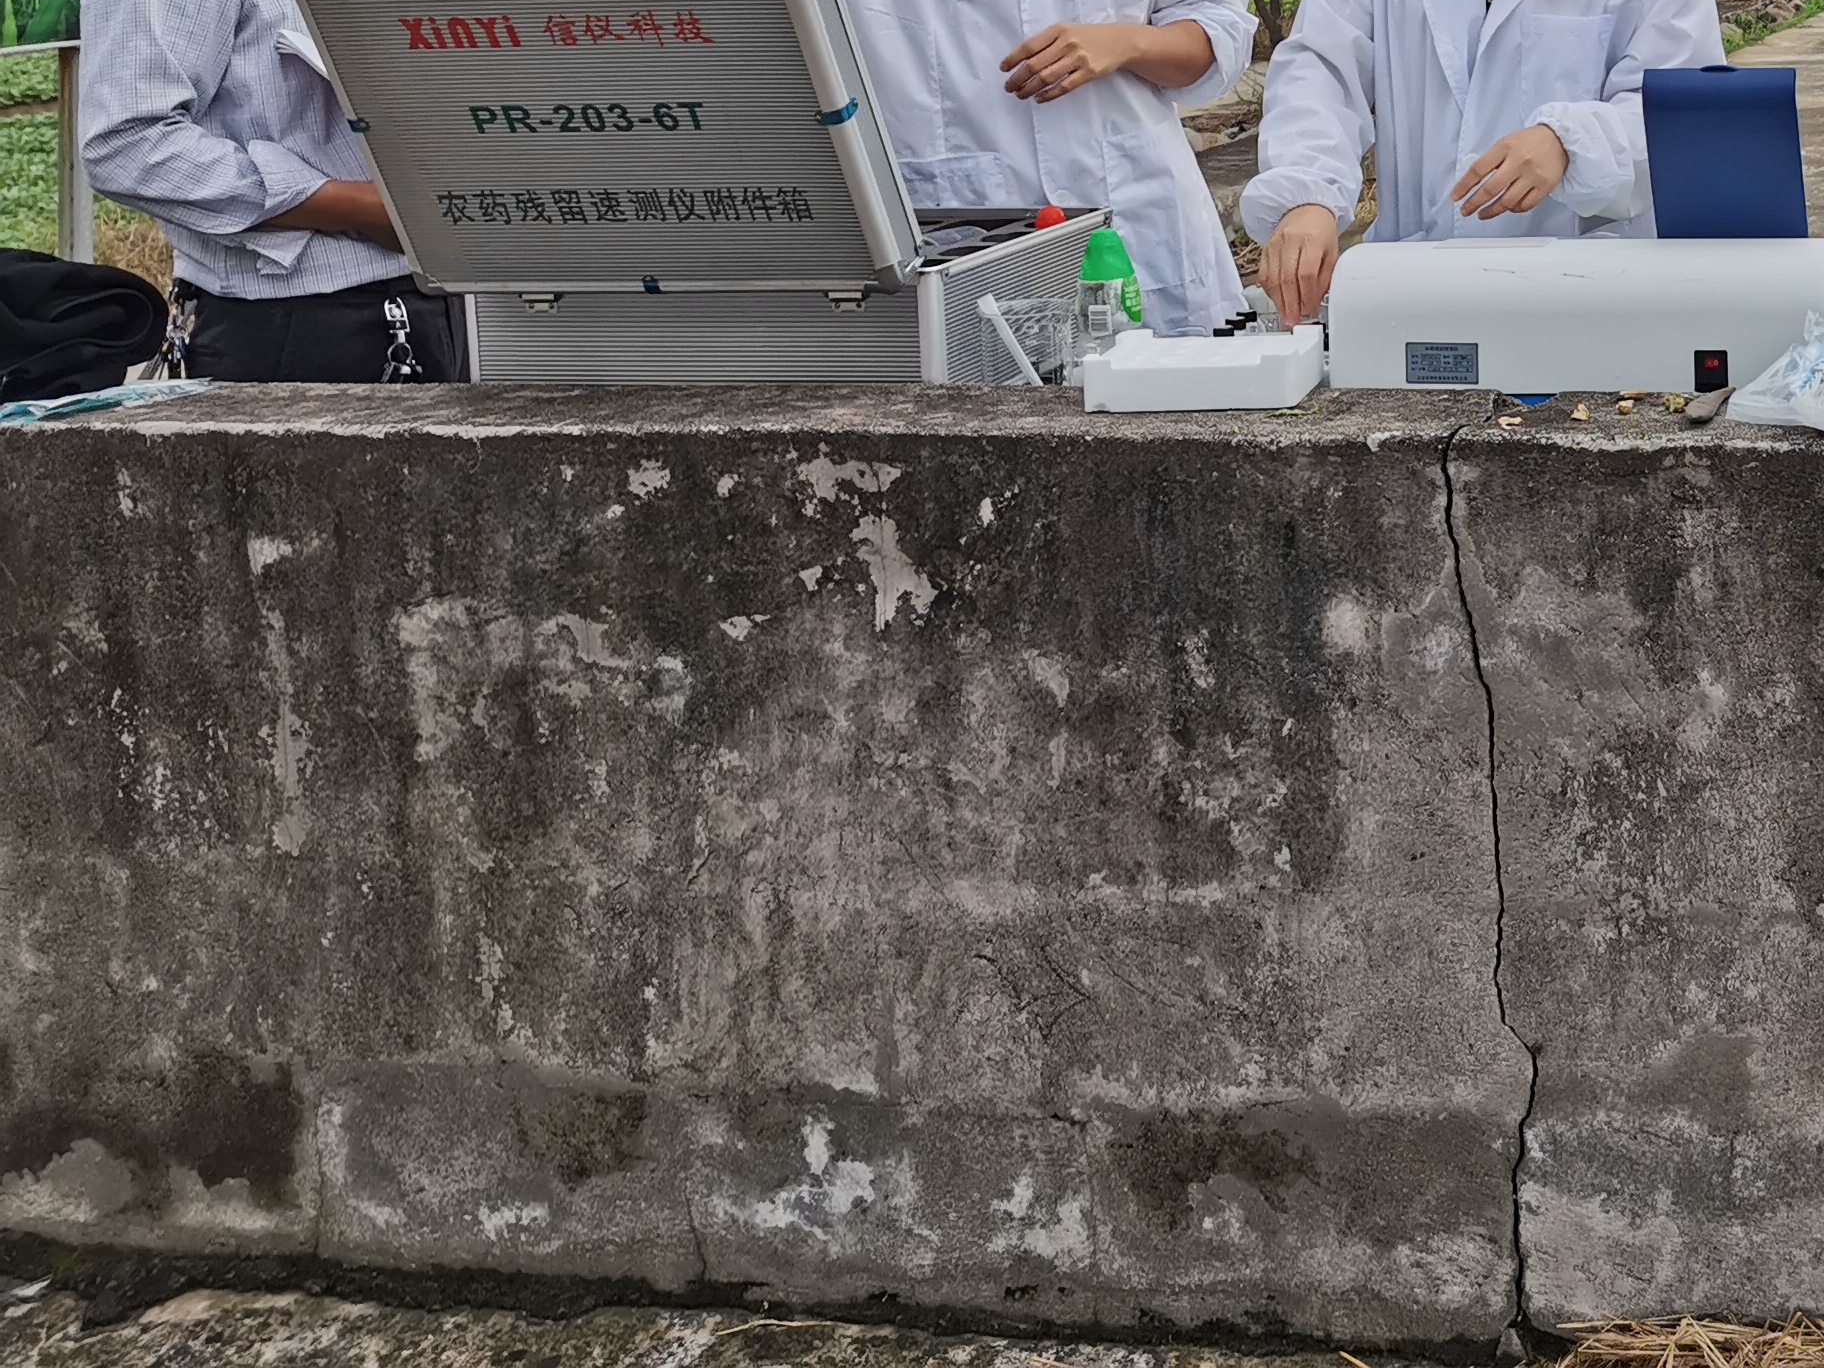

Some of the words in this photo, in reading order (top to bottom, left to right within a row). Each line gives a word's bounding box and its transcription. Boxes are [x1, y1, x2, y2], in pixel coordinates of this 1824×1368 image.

[543, 9, 714, 48] 信仪科技
[468, 101, 704, 134] PR-203-6T
[436, 186, 814, 226] 农药残留速测仪附件箱
